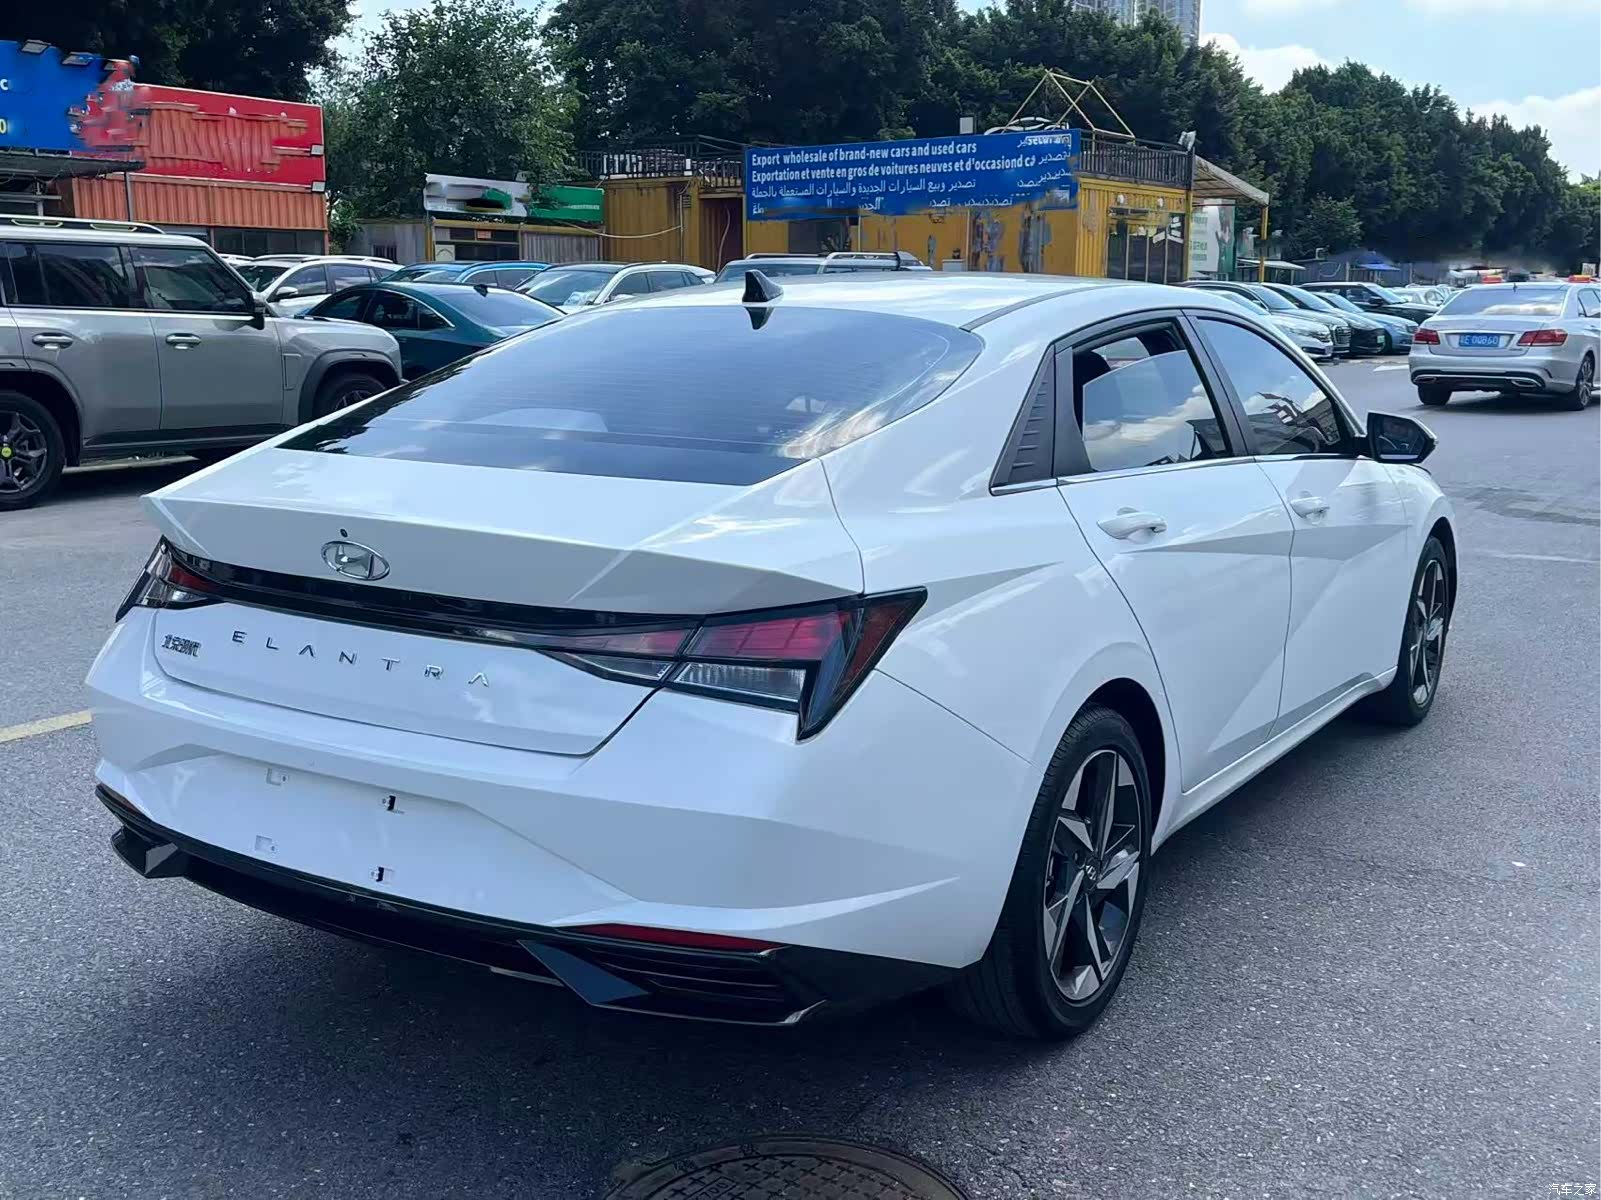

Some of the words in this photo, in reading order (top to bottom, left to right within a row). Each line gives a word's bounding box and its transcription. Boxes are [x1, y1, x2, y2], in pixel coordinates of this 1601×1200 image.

[752, 153, 780, 168] Export
[783, 149, 827, 164] wholesale
[828, 148, 839, 161] of
[839, 146, 889, 161] brand-new
[890, 146, 910, 158] cars
[911, 142, 930, 157] and
[931, 141, 955, 155] used
[956, 142, 977, 155] cars
[752, 168, 800, 184] Exportation
[801, 168, 810, 180] et
[811, 167, 835, 179] vente
[836, 167, 847, 177] en
[848, 166, 867, 180] gros
[868, 163, 880, 176] de
[880, 162, 918, 175] voitures
[920, 162, 953, 173] neuves
[954, 159, 964, 172] et
[816, 181, 857, 198] والسيارات
[858, 179, 886, 195] الجديدة
[888, 178, 926, 195] السيارات
[927, 181, 946, 193] وبيع
[948, 178, 976, 192] تصدير
[232, 631, 489, 688] ELANTRA
